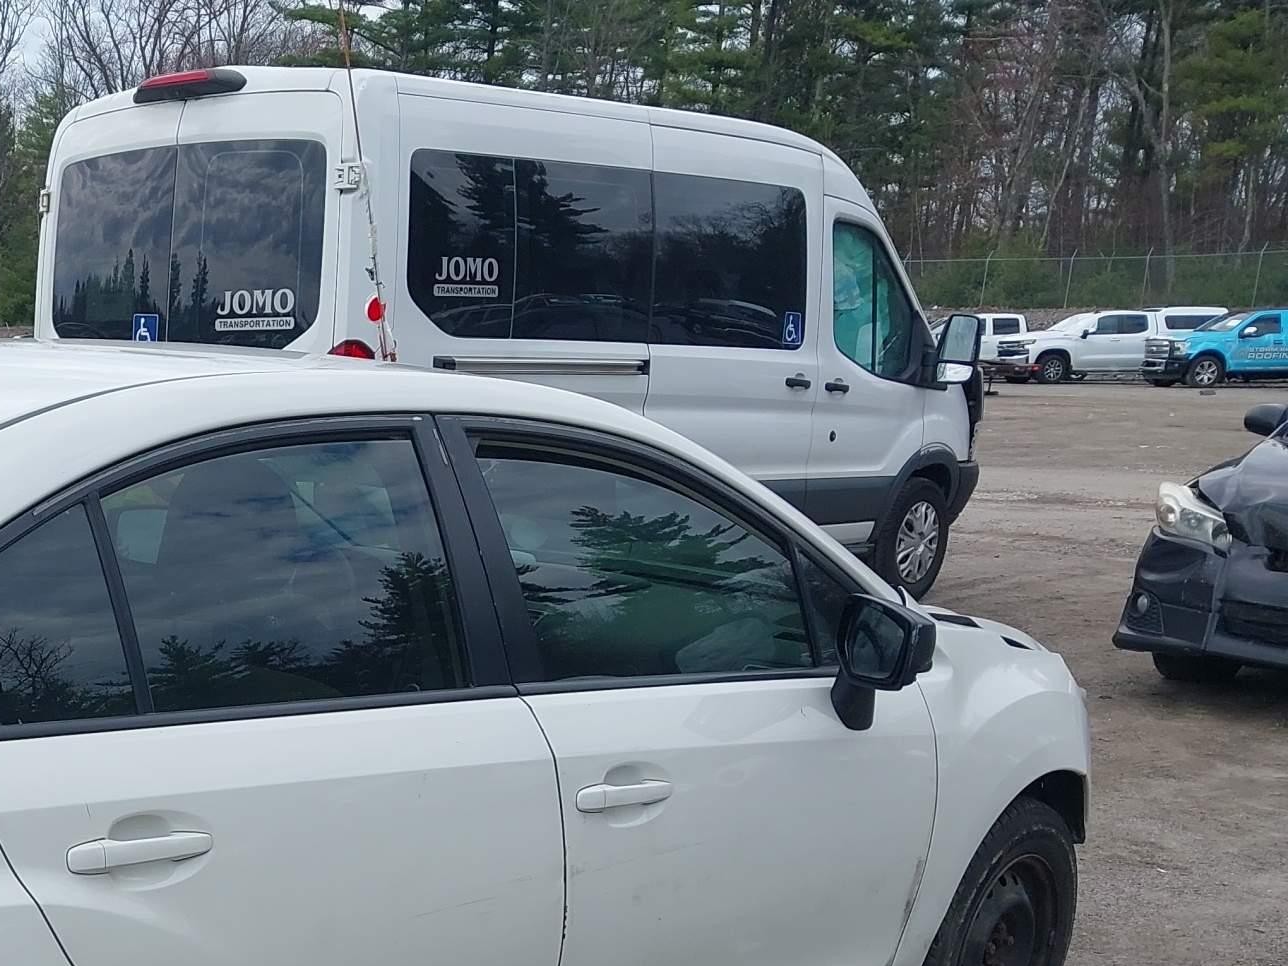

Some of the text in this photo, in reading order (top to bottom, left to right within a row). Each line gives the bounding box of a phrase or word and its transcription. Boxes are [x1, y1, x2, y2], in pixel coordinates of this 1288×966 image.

[435, 256, 499, 282] JOMO
[436, 285, 497, 296] TRANSPORTATION
[216, 288, 295, 316] JOMO
[217, 319, 292, 329] TRANSPORTATION
